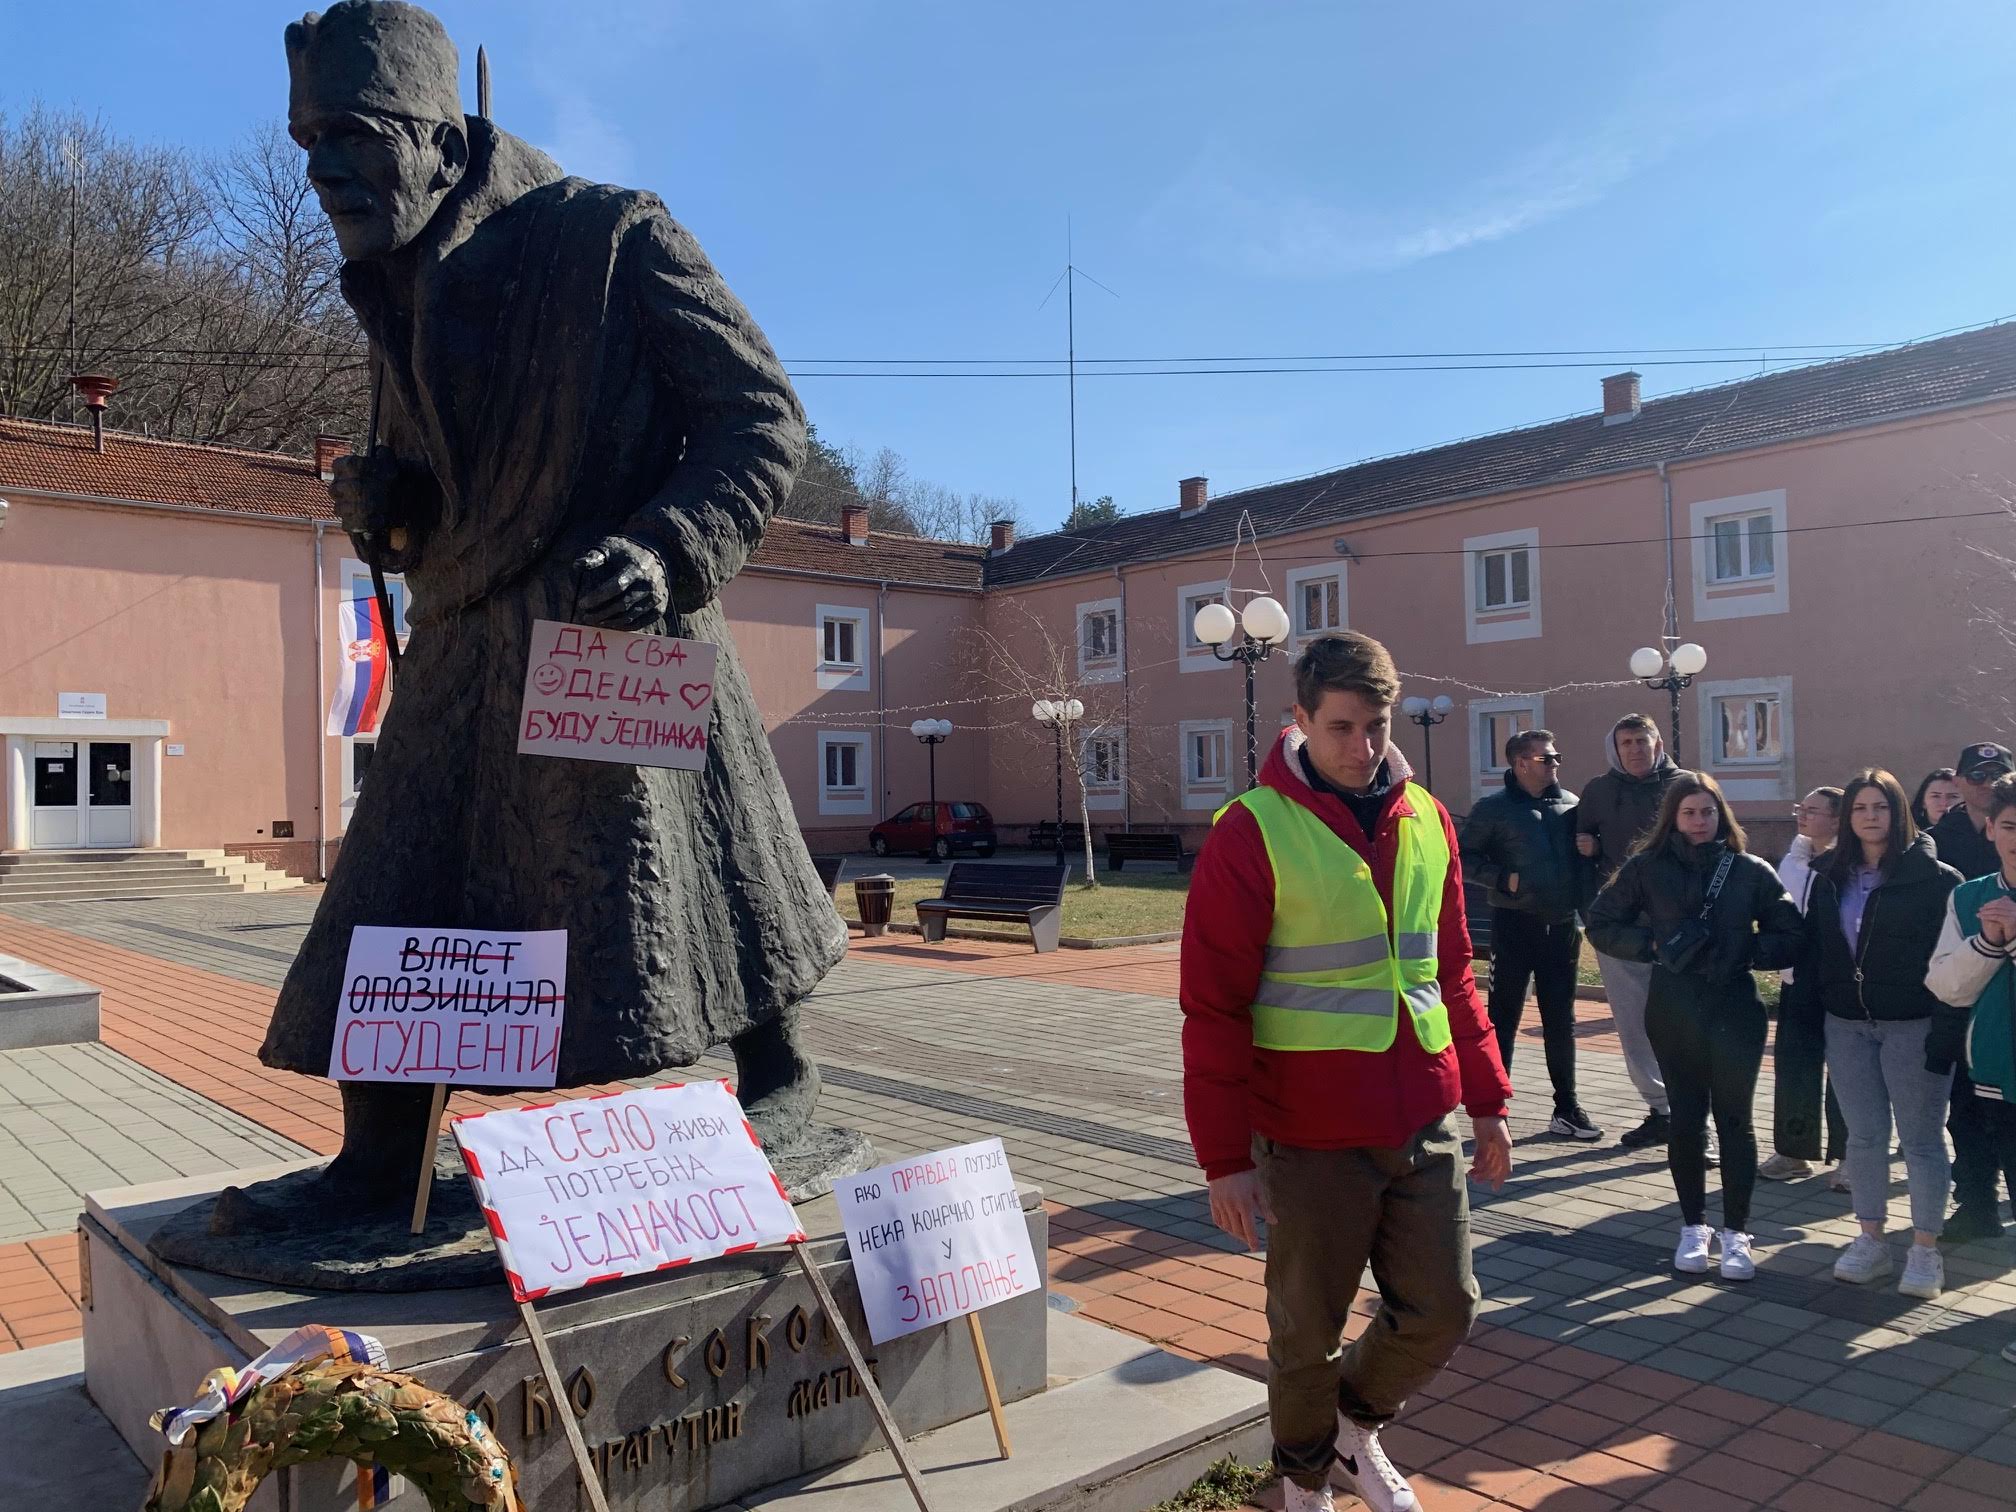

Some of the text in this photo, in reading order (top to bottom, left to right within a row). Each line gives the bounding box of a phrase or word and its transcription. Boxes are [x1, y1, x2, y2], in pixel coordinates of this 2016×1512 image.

[550, 628, 688, 667] ДА СВА
[565, 669, 670, 705] ДЕЦА
[525, 710, 599, 744] БУДУ
[401, 936, 522, 975] ВЛАСТ
[349, 975, 557, 1017] ОПОЗИЦИЈА
[342, 1019, 560, 1078] СТУДЕНТИ
[498, 1104, 731, 1176] ДА СЕЛО ЖИВИ
[544, 1153, 713, 1204] ПОТРЕБНА
[854, 1150, 1003, 1204] АКО ПРАВДА ПУТУЈЕ
[858, 1189, 1021, 1252] НЕКА КОНАЧНО СТИГНЕ
[941, 1238, 952, 1260] У
[897, 1254, 1024, 1323] ЗАПЛАЊЕ
